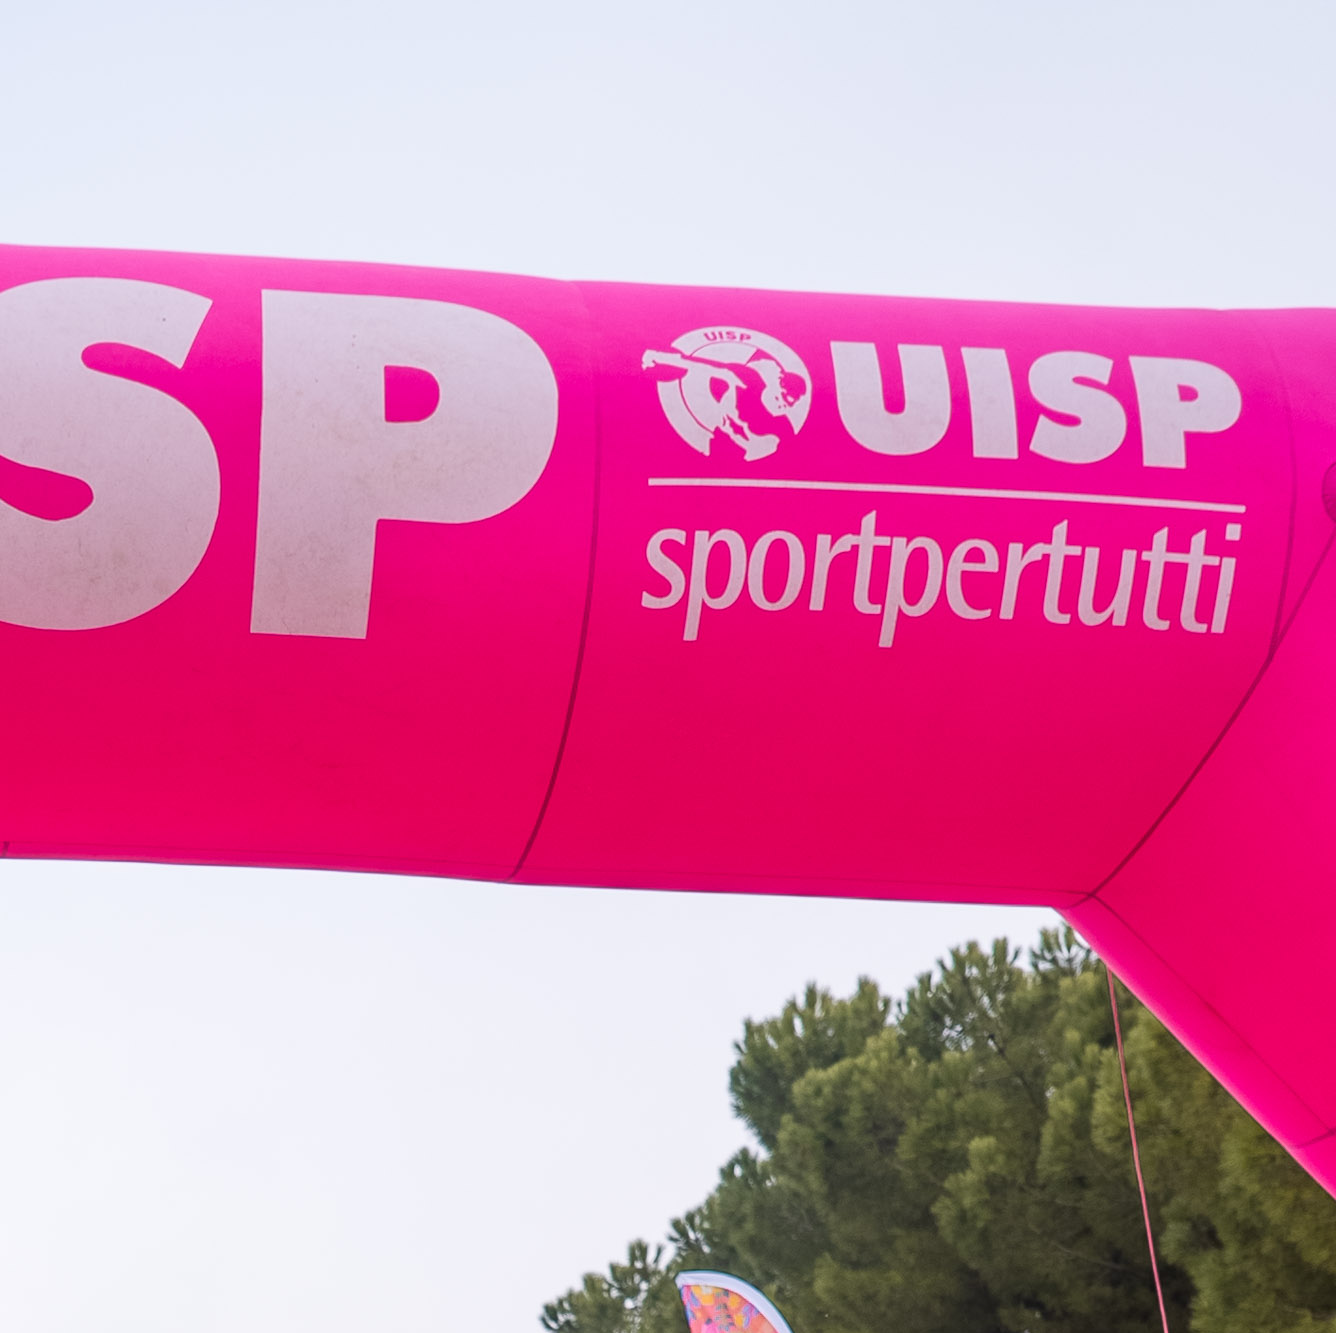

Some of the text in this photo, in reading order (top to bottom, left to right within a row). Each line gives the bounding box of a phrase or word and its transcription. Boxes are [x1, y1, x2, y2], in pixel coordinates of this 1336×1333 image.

[704, 331, 752, 342] UISP
[830, 340, 1243, 469] UISP
[640, 510, 1243, 648] sportpertutti
